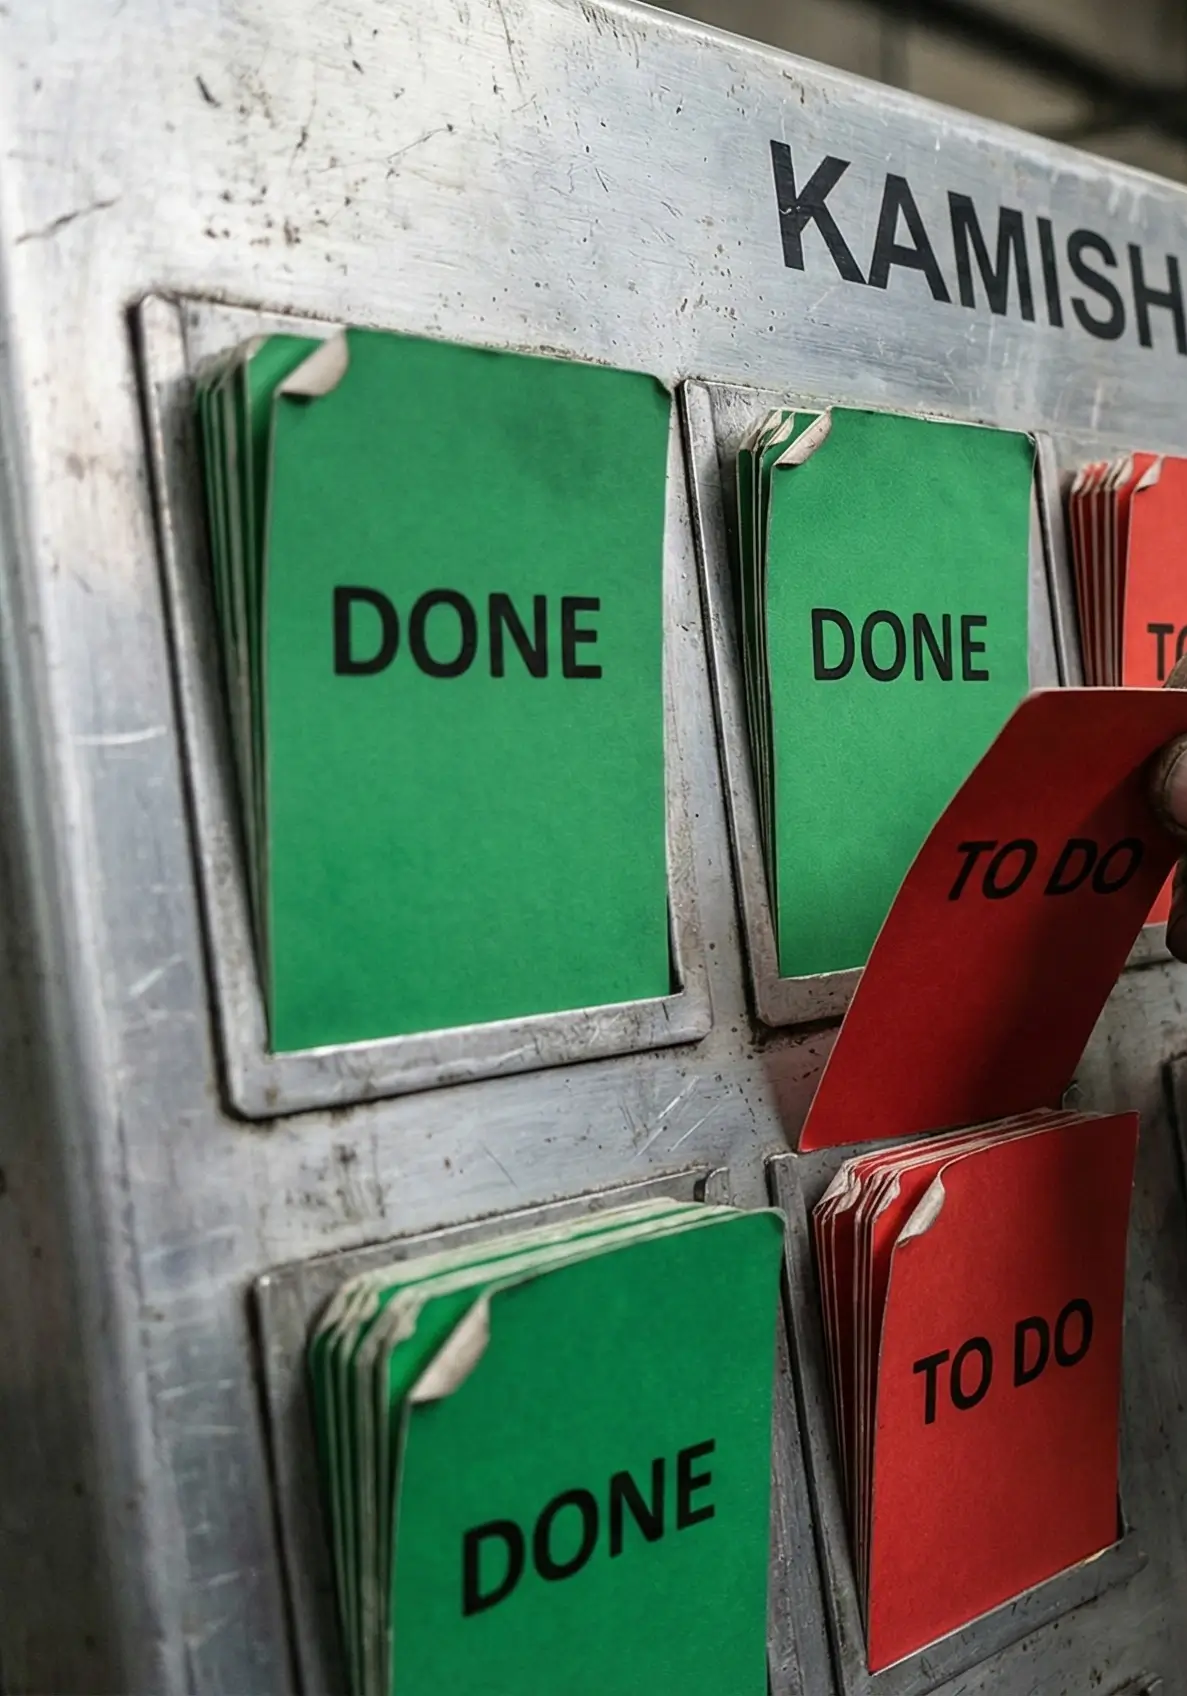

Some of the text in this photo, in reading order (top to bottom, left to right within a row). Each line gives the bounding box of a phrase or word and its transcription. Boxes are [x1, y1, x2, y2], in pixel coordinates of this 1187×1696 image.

[332, 585, 603, 680] DONE
[811, 607, 990, 683] DONE
[948, 837, 1144, 901] TO DO
[912, 1297, 1096, 1426] TO DO
[460, 1439, 716, 1619] DONE
